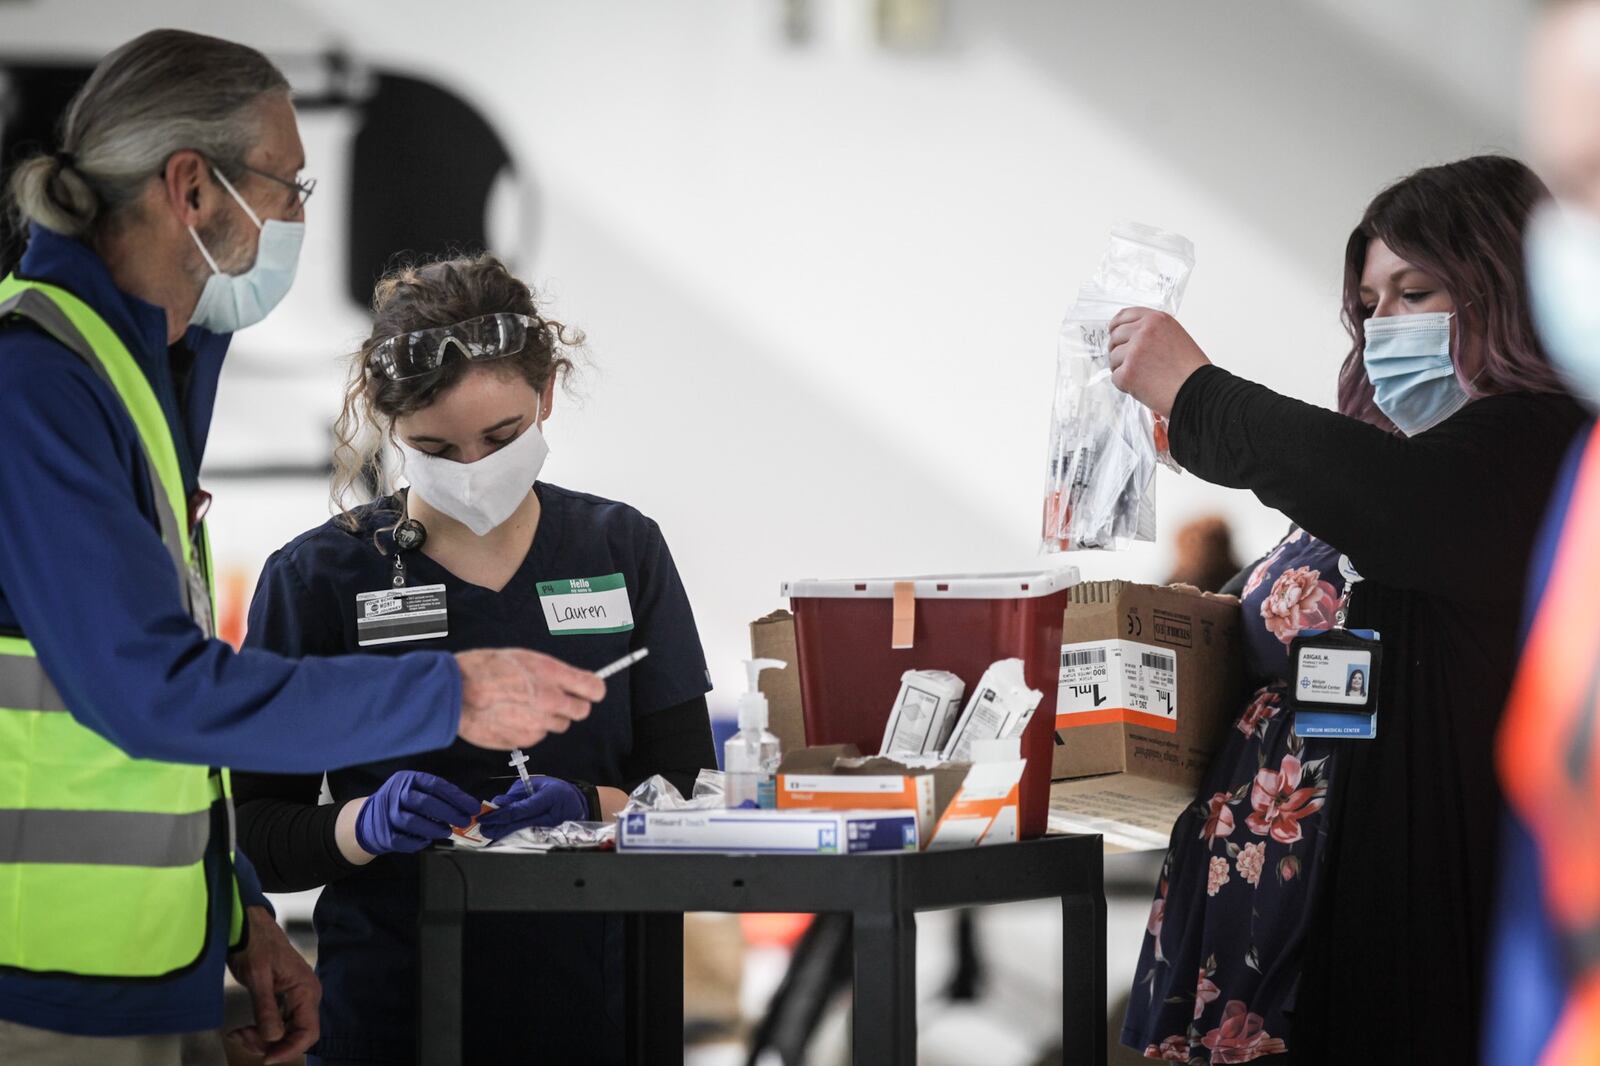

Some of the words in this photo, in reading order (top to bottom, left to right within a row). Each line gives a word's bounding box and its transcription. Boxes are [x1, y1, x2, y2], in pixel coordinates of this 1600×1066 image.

[570, 579, 589, 588] Hello
[552, 602, 607, 623] Lauren
[1167, 626, 1191, 640] STERILE
[1093, 668, 1106, 676] 800
[1069, 684, 1106, 706] 1mL
[1156, 689, 1173, 715] 1mL
